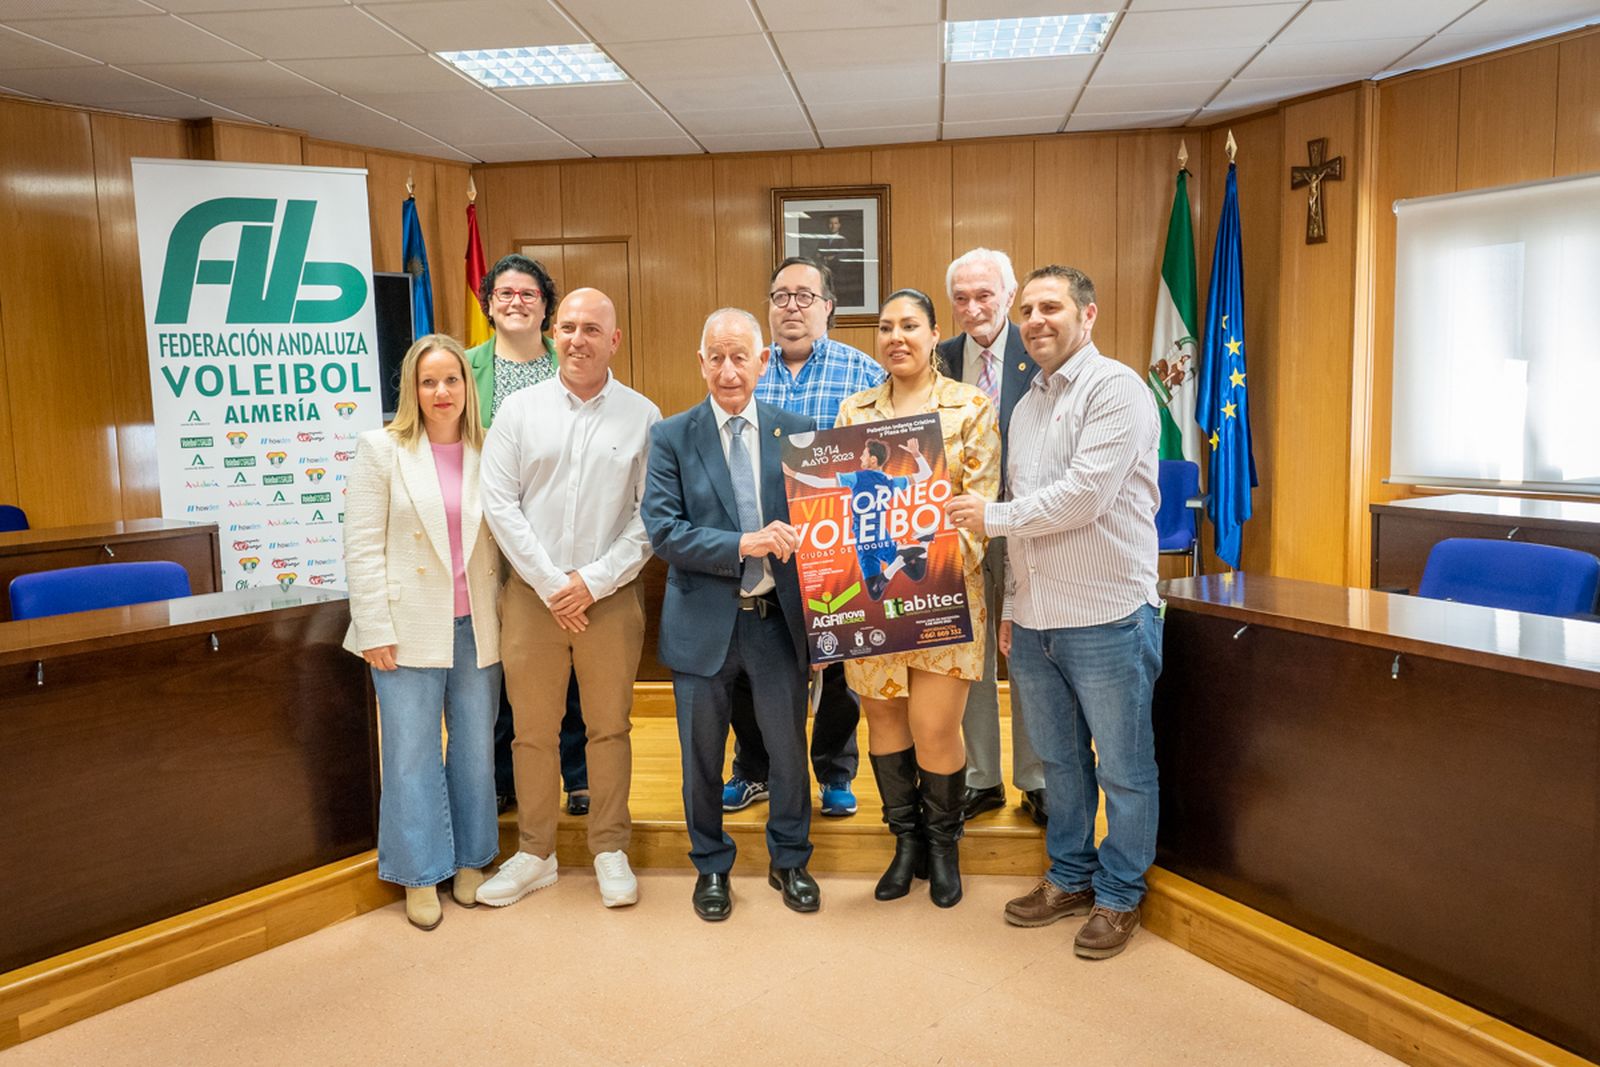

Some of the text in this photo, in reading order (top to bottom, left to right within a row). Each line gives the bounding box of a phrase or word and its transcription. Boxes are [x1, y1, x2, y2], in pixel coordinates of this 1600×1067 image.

[158, 328, 368, 358] FEDERACIÓN ANDALUZA
[160, 362, 372, 398] VOLEIBOL
[224, 398, 321, 424] ALMERÍA
[812, 444, 839, 457] 13/14
[832, 452, 855, 463] 2023
[801, 479, 951, 521] VII TORNEO
[800, 548, 836, 560] CIUDAD
[840, 546, 852, 554] DE
